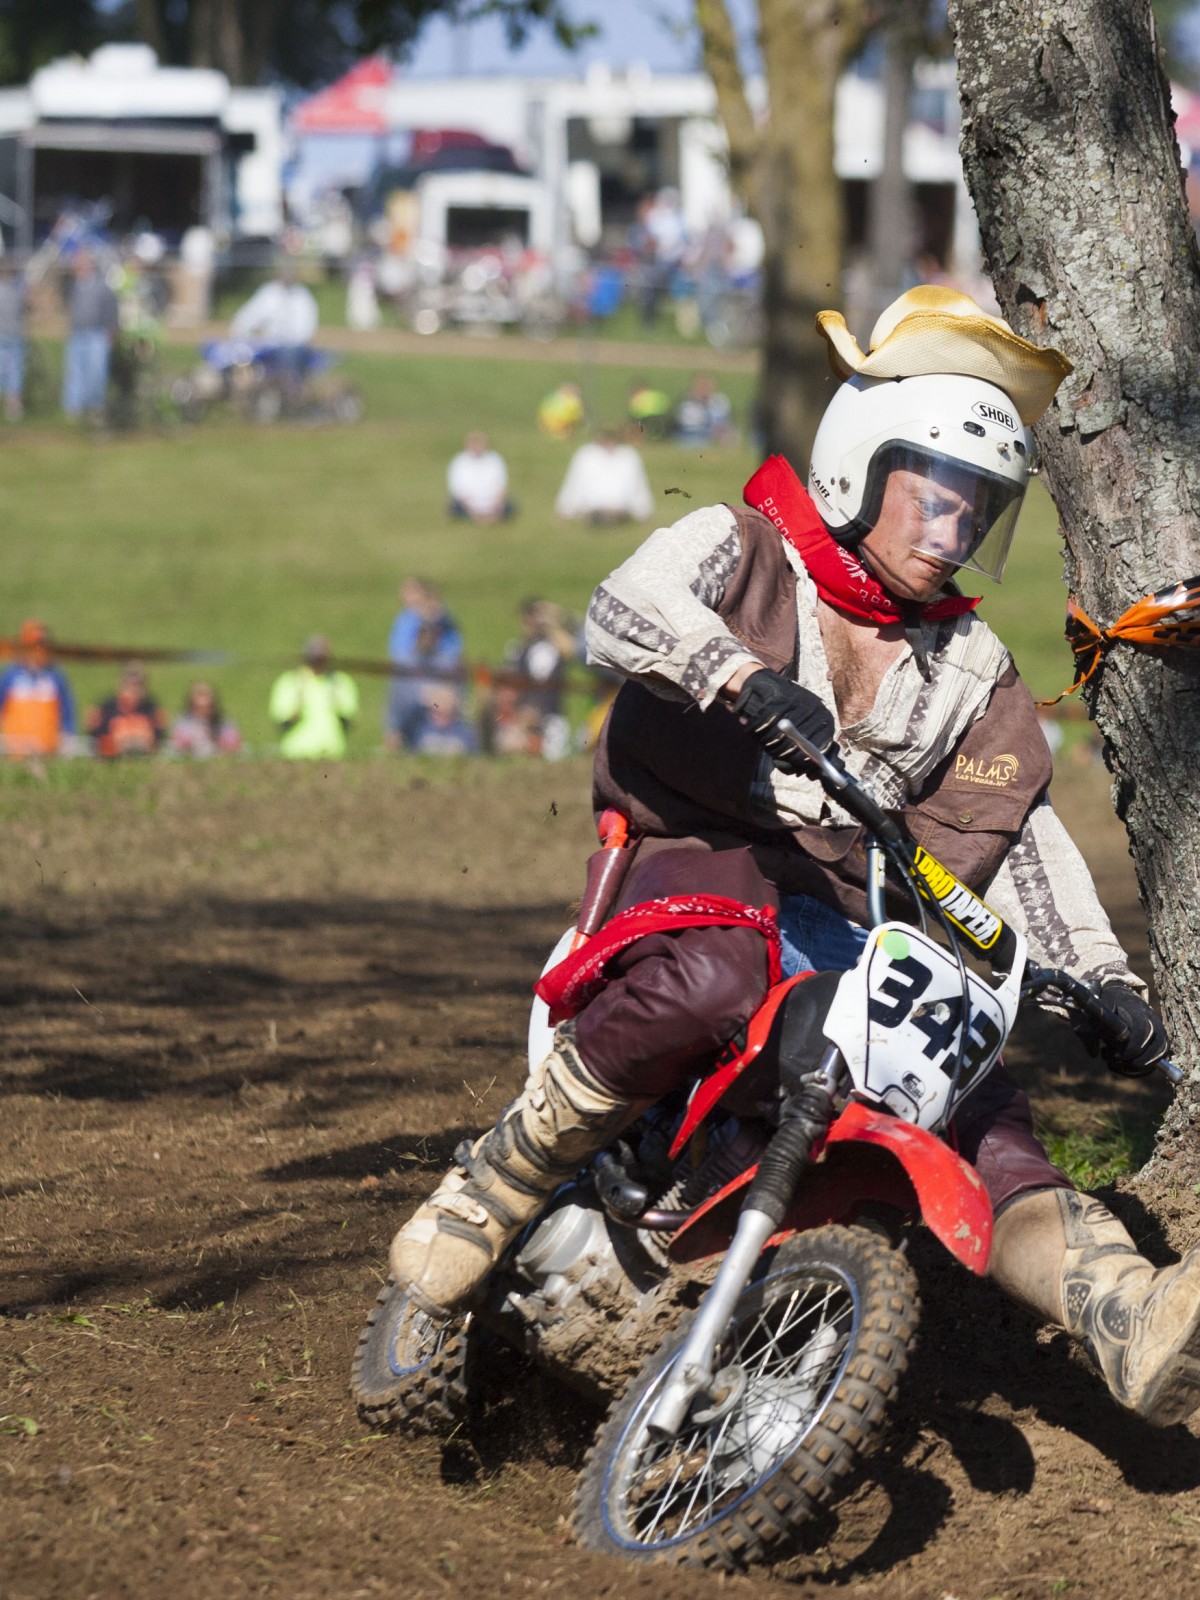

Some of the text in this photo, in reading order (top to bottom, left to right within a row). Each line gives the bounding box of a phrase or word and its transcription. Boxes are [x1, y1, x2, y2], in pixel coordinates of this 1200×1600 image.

[979, 404, 1014, 429] SHOEI
[955, 754, 1012, 780] PALMS
[955, 773, 969, 781] LAS
[868, 955, 1001, 1090] 343
